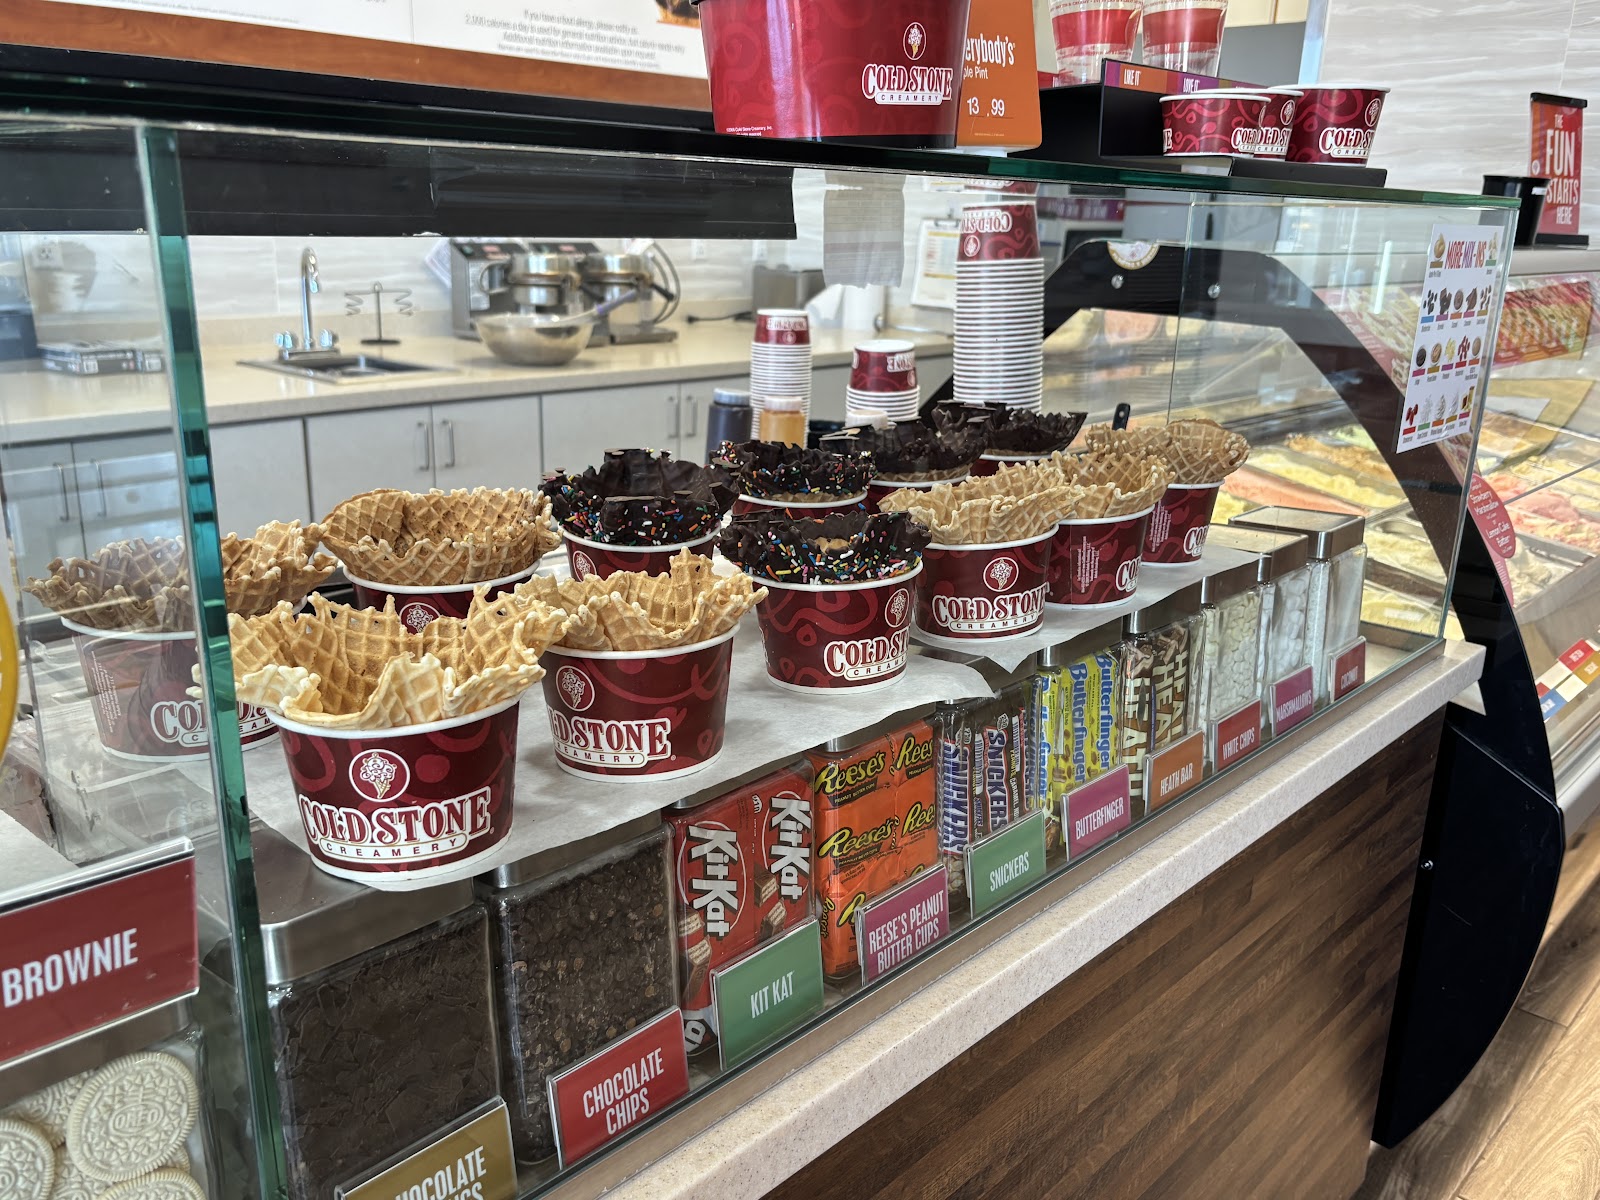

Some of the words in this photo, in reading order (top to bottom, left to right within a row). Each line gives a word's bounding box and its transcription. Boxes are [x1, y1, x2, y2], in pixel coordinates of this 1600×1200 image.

[862, 64, 908, 99] COLD
[909, 66, 953, 100] STONE
[881, 94, 939, 102] CREAMERY
[1554, 113, 1564, 128] THE
[1319, 127, 1363, 154] COLD
[1545, 129, 1575, 177] FUN
[1546, 178, 1579, 205] STARTS
[1556, 206, 1572, 225] HERE
[1444, 241, 1465, 270] MORE
[932, 594, 992, 627] COLD
[956, 615, 1035, 629] CREAMERY
[824, 636, 889, 677] COLD
[1068, 662, 1088, 782] Butterfinger
[1094, 654, 1114, 769] Butterfinger
[1275, 689, 1312, 722] MARSHMALLOWS
[571, 716, 671, 760] STONE
[1222, 741, 1239, 760] WHITE
[1239, 727, 1255, 752] CHIPS
[814, 751, 886, 794] Reese's
[986, 730, 1008, 832] SNICKERS
[1160, 770, 1180, 797] HEATH
[1180, 762, 1194, 784] BAR
[834, 794, 852, 804] PEANUT
[852, 787, 866, 797] BUTTER
[865, 783, 875, 791] CUPS
[299, 794, 372, 845] COLD
[372, 786, 491, 844] STONE
[902, 802, 935, 837] Ree
[1075, 797, 1124, 840] BUTTERFINGER
[326, 838, 457, 858] CREAMERY
[818, 819, 894, 858] Reese's
[989, 851, 1030, 892] SNICKERS
[869, 913, 908, 955] REESE'S
[910, 890, 944, 931] PEANUT
[877, 929, 914, 975] BUTTER
[915, 917, 940, 950] CUPS
[1, 927, 139, 1008] BROWNIE
[750, 988, 771, 1019] KIT
[772, 971, 794, 1002] KAT
[582, 1047, 665, 1119] CHOCOLATE
[114, 1107, 158, 1130] OREO
[606, 1087, 651, 1136] CHIPS
